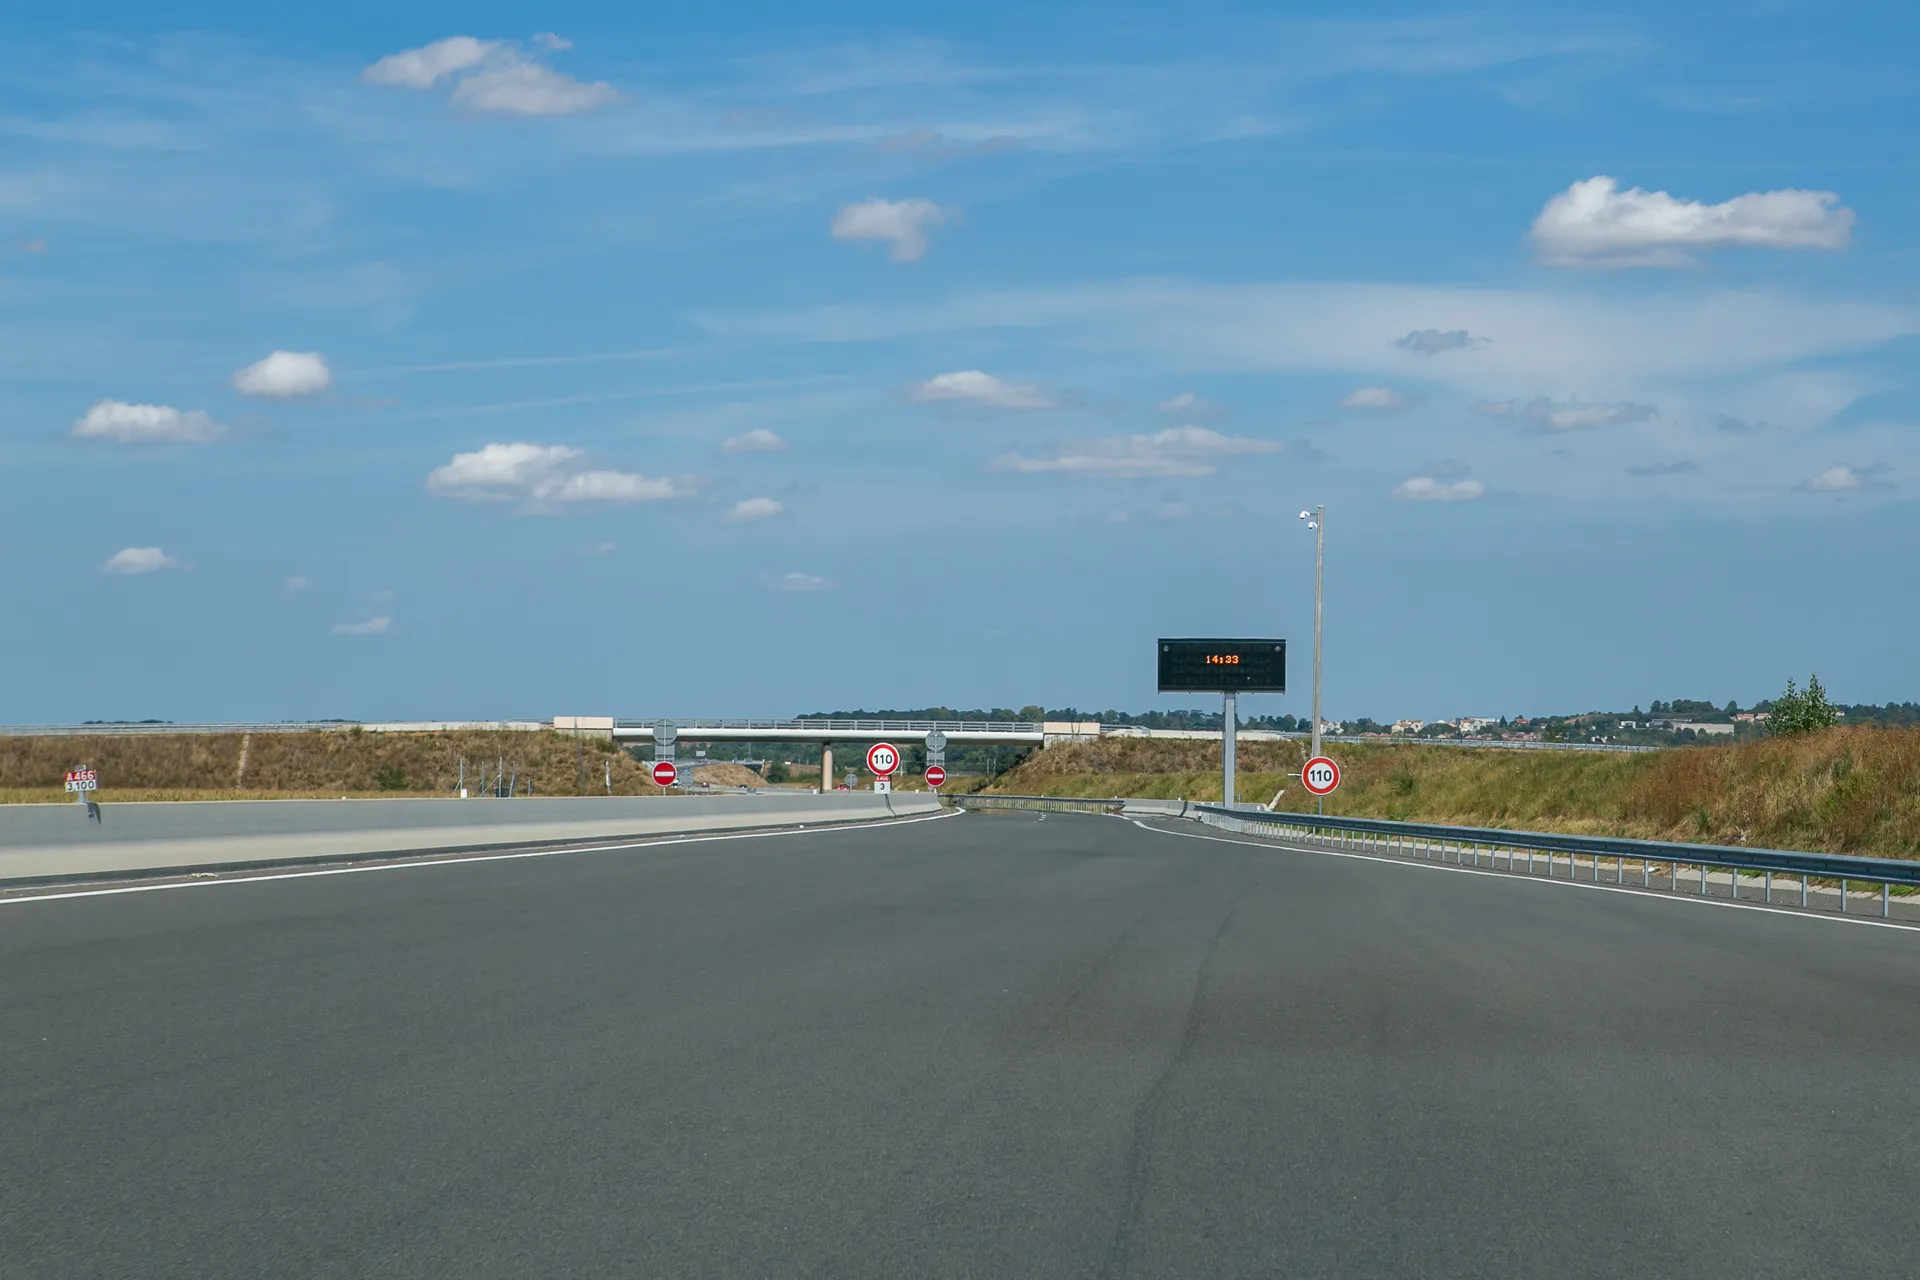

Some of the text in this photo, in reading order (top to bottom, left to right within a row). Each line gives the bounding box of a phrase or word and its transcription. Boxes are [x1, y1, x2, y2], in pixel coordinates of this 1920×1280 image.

[1206, 655, 1239, 664] 14:33
[874, 754, 893, 764] 110
[67, 770, 94, 781] A 466
[1310, 770, 1332, 781] 110
[880, 782, 885, 790] 3
